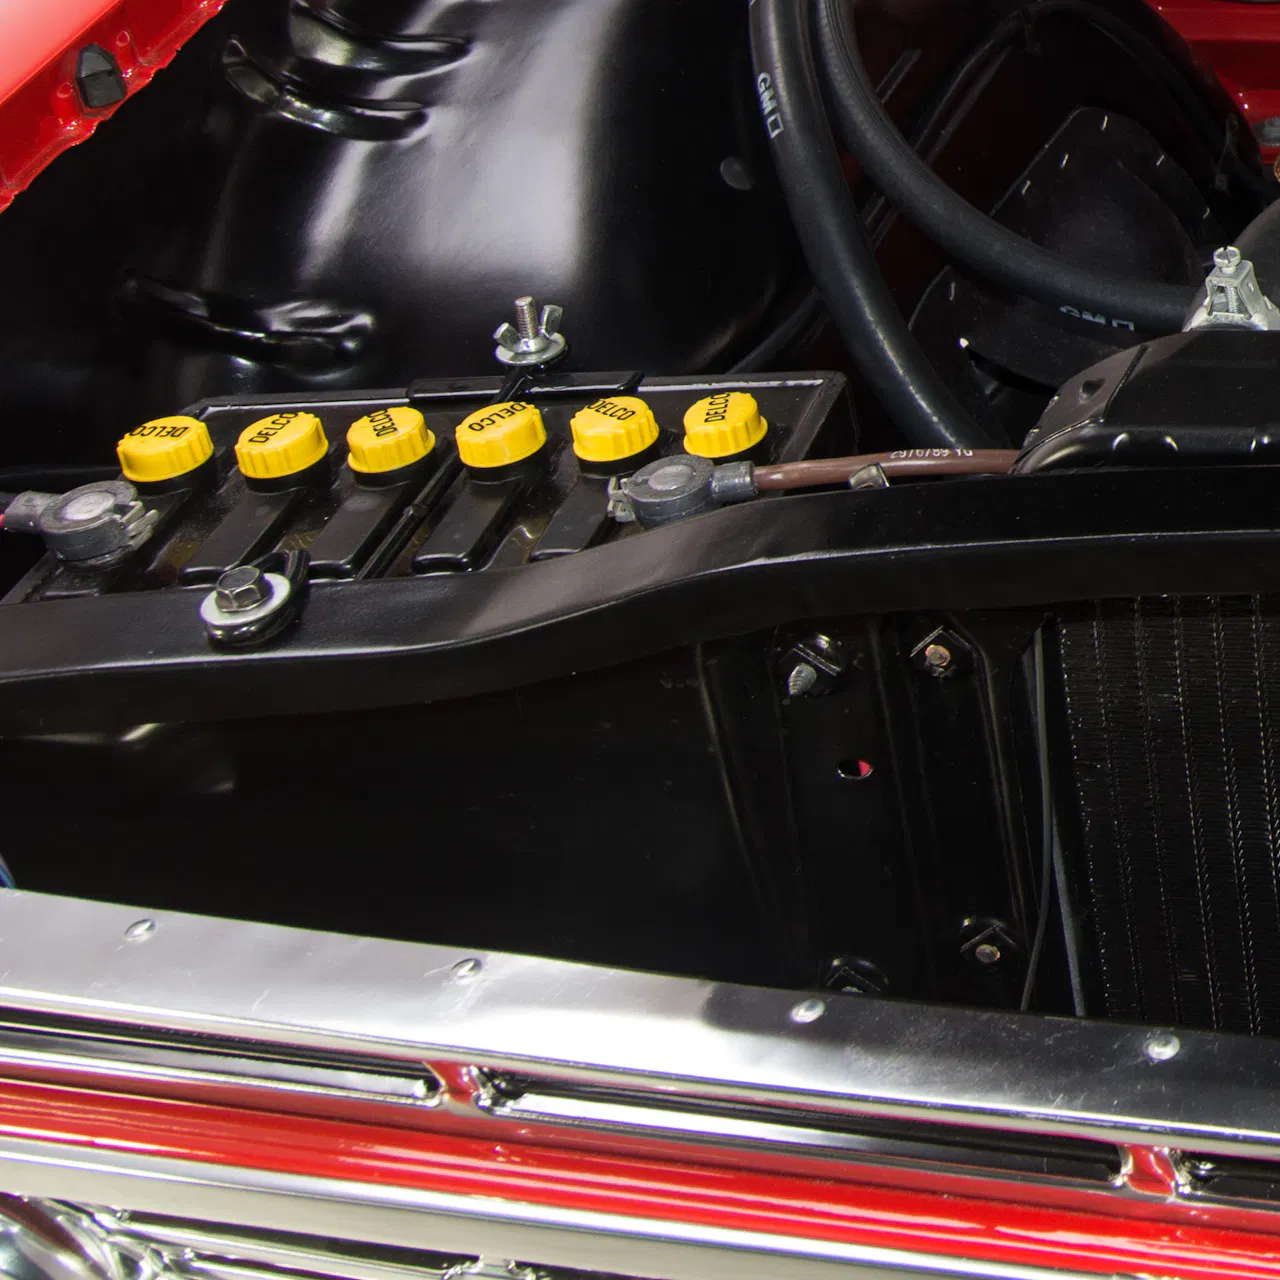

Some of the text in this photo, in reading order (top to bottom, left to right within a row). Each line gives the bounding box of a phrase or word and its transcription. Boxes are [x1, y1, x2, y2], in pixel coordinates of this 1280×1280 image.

[757, 72, 777, 115] GM
[468, 402, 528, 432] DELCO
[586, 399, 636, 421] DELCO
[704, 392, 731, 423] DELCO
[129, 425, 189, 438] DELCO
[247, 412, 299, 444] DELCO
[366, 409, 398, 438] DELCO
